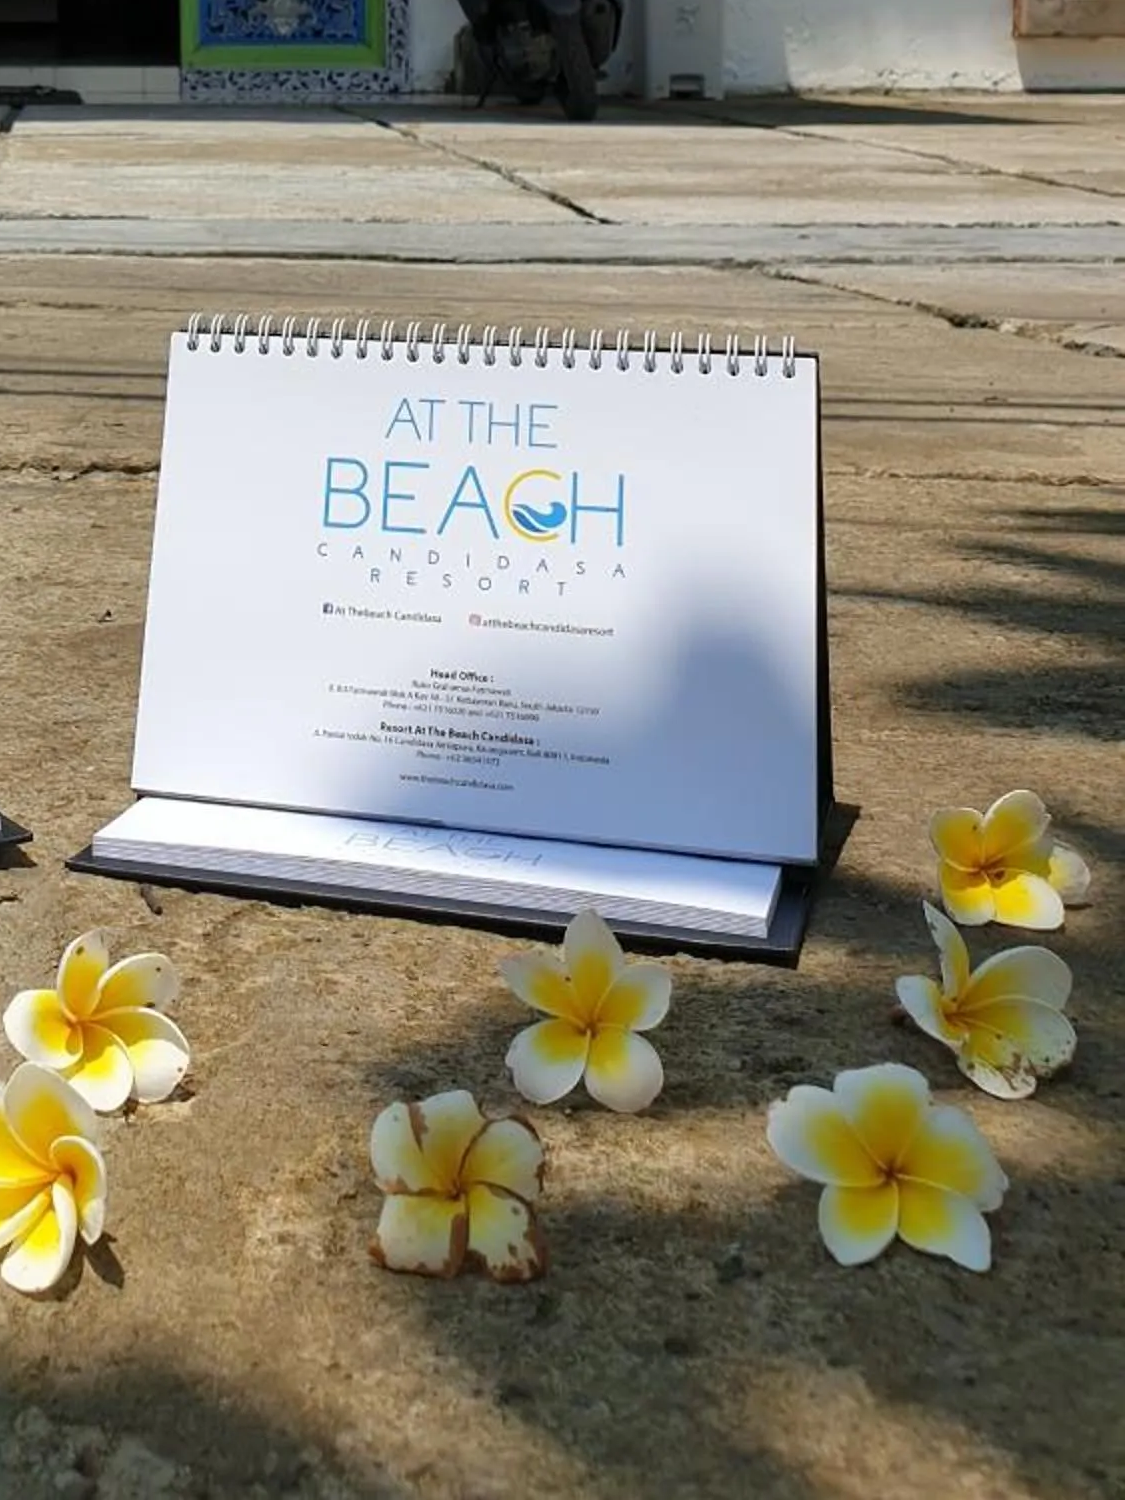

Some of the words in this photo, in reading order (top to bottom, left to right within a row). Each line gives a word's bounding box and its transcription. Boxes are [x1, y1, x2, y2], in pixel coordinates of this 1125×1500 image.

[385, 398, 446, 441] AT
[458, 401, 558, 449] THE
[322, 457, 625, 547] BEACH
[316, 542, 627, 579] CANDIDASA
[369, 567, 567, 597] RESORT
[431, 668, 457, 680] Head
[458, 671, 489, 683] Office
[380, 721, 412, 735] Resort
[414, 725, 426, 735] At
[428, 726, 446, 738] The
[448, 728, 479, 742] Beach
[481, 731, 534, 746] Candidasa
